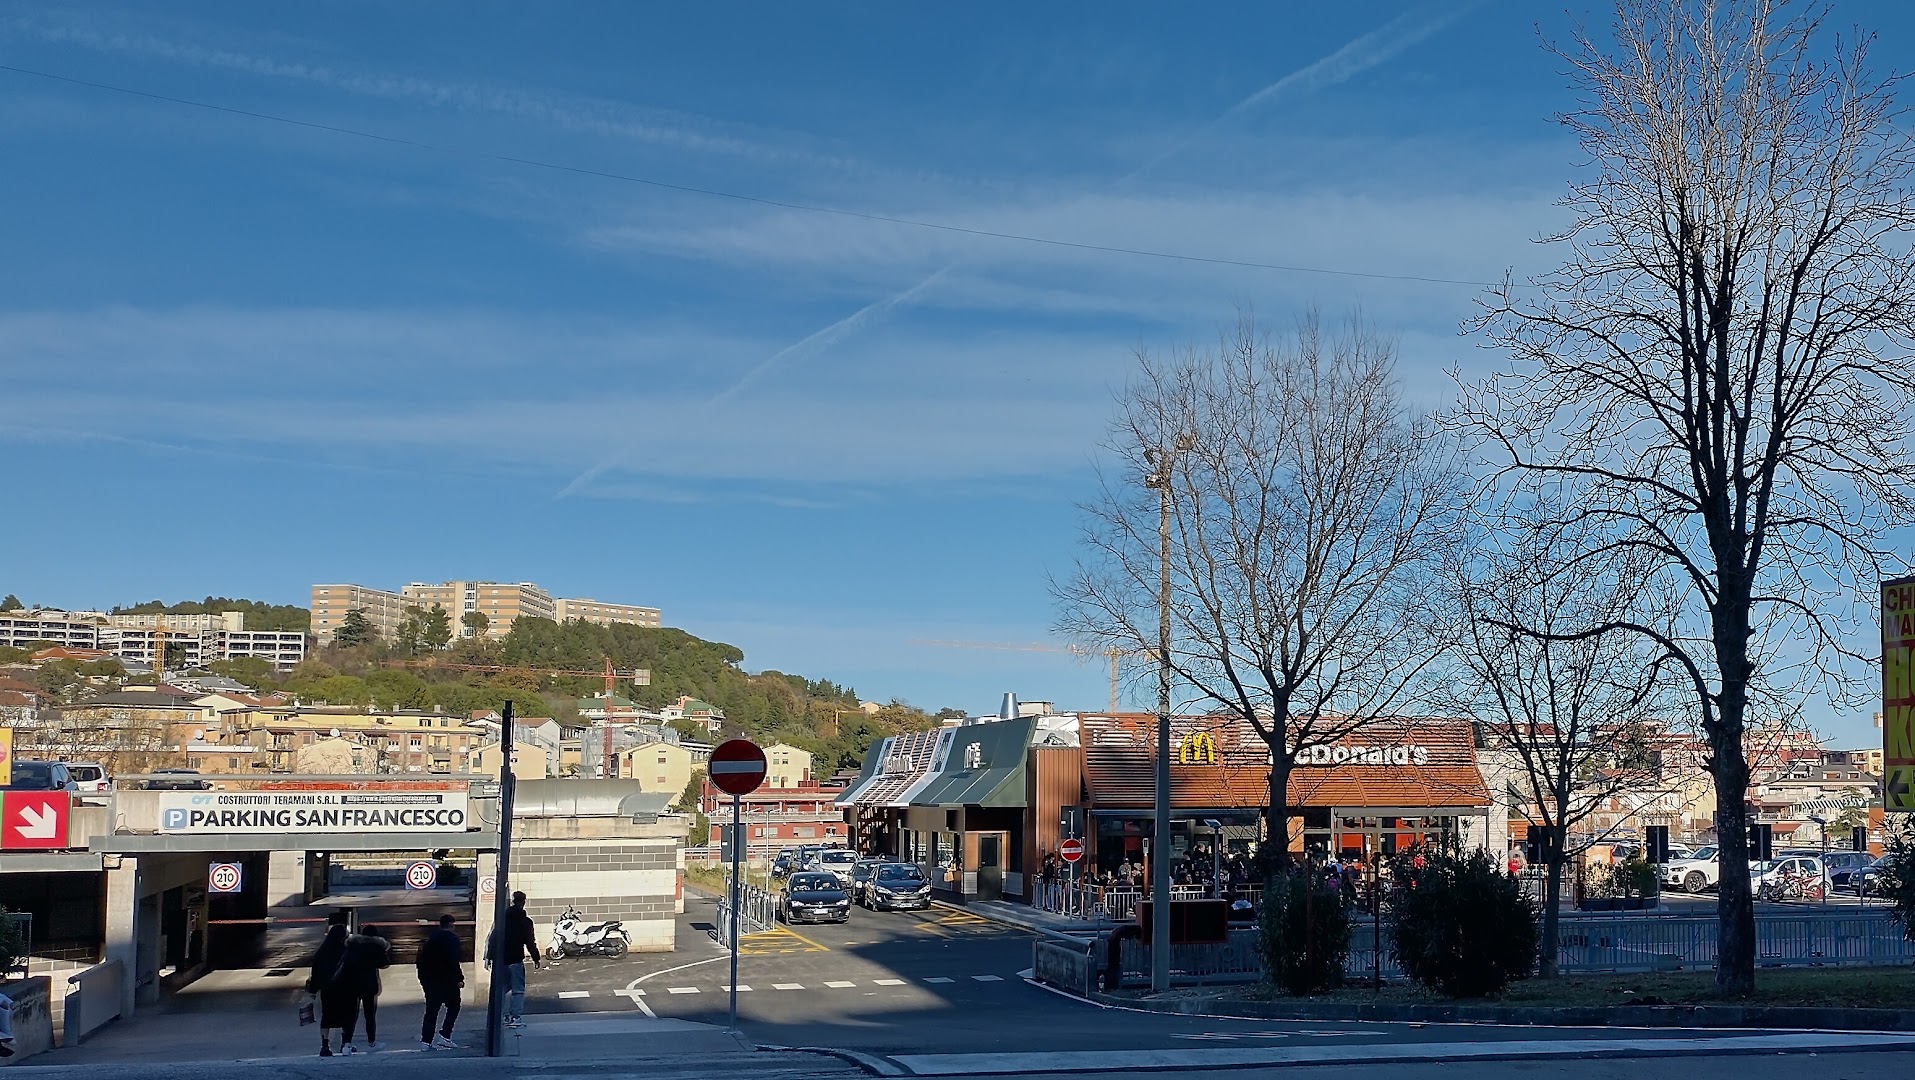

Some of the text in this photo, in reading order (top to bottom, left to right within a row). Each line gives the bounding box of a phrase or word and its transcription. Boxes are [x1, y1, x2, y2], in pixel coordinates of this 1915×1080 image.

[1885, 585, 1915, 612] CH
[1886, 613, 1915, 637] MA
[218, 795, 339, 805] COSTRUTTORI TERAMANI S.R.L.
[168, 809, 464, 827] P PARKING SAN FRANCESCO
[216, 873, 234, 883] 210
[413, 870, 430, 880] 210
